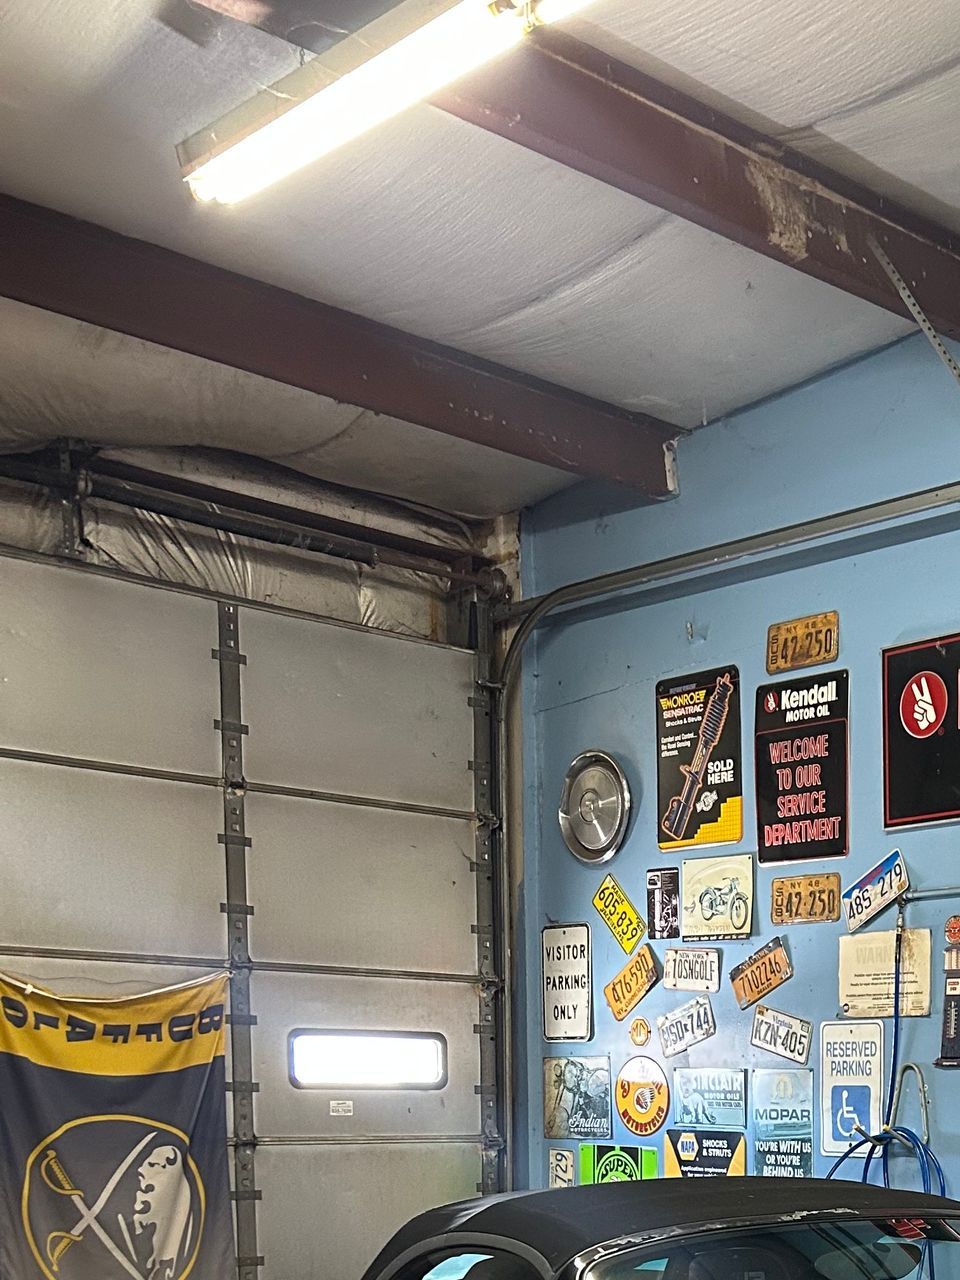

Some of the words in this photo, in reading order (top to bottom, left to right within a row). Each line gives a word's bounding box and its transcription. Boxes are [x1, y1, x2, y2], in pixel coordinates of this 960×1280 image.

[660, 690, 707, 709] MONROE
[781, 681, 838, 711] Kendall
[663, 704, 704, 718] SENSATRAC
[785, 709, 812, 723] MOTOR
[815, 704, 831, 716] OIL
[769, 734, 830, 765] WELCOME
[707, 758, 734, 773] SOLD
[707, 769, 734, 785] HERE
[776, 767, 793, 791] TO
[795, 763, 822, 788] OUR
[777, 791, 826, 818] SERVICE
[764, 816, 842, 848] DEPARTMENT
[877, 862, 903, 898] 279
[546, 944, 586, 961] VISITOR
[546, 974, 588, 991] PARKING
[738, 960, 782, 998] 7102246
[553, 1004, 578, 1021] ONLY
[687, 1007, 709, 1034] 744
[754, 1019, 807, 1056] KZN-405
[826, 1041, 877, 1058] RESERVED
[831, 1060, 872, 1076] PARKING
[568, 1111, 608, 1129] Indian
[621, 1106, 664, 1133] MOTORCYCLES
[755, 1109, 811, 1121] MOPAR
[681, 1141, 695, 1153] NAPA
[703, 1140, 728, 1149] SHOCKS
[755, 1141, 779, 1152] YOU'RE
[779, 1140, 801, 1154] WITH
[802, 1143, 811, 1152] US
[708, 1149, 732, 1158] STRUTS
[766, 1154, 777, 1164] OR
[777, 1153, 800, 1166] YOU'RE
[763, 1165, 793, 1178] BEHIND
[795, 1169, 804, 1177] US
